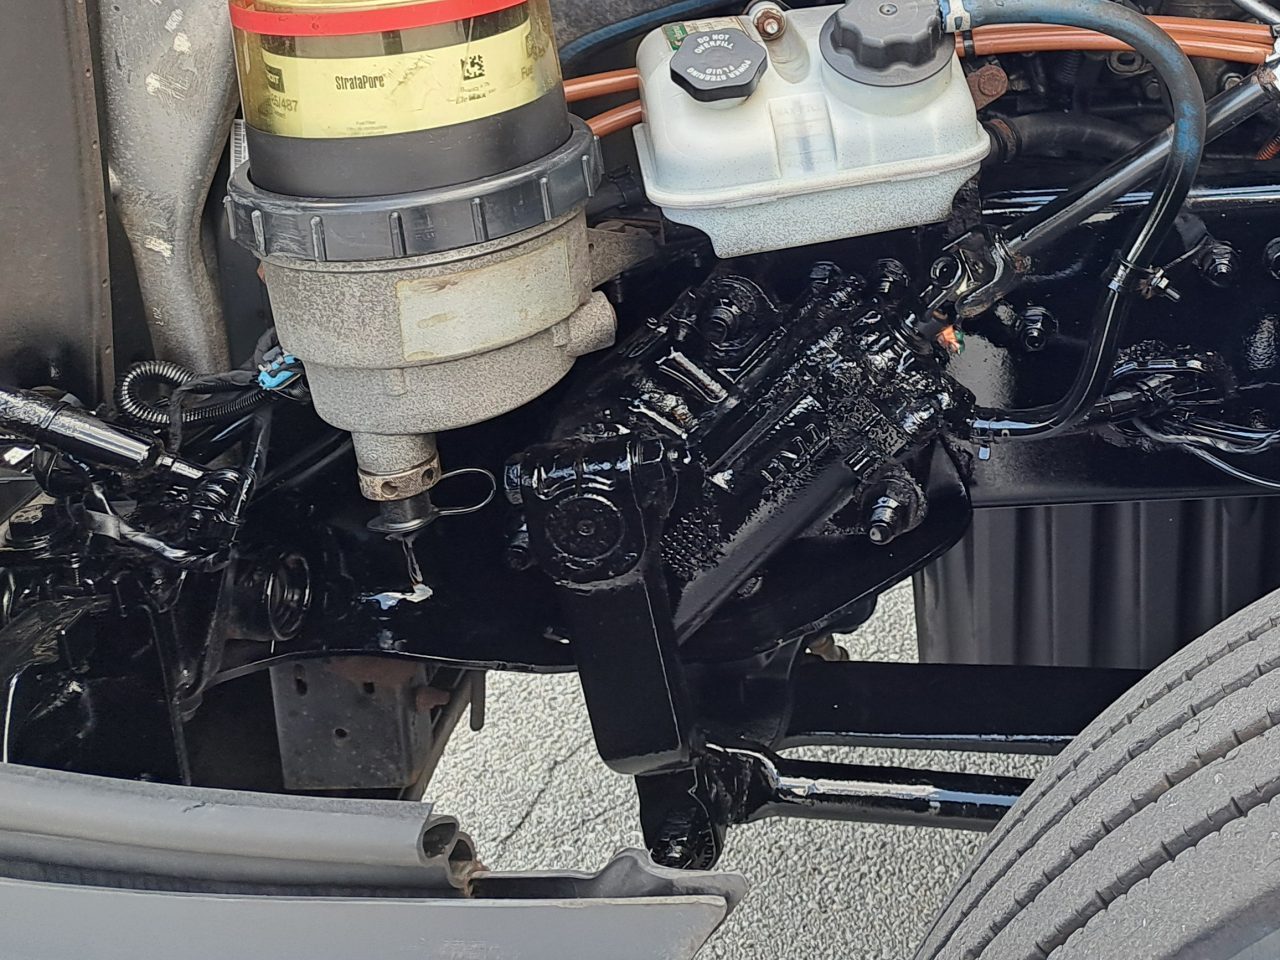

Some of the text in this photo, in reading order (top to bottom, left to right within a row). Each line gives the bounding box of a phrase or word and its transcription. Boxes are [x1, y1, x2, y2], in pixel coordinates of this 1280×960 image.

[697, 35, 710, 44] DO
[694, 41, 734, 54] OVERFILL
[686, 59, 752, 81] POWER STEERING
[705, 65, 735, 75] FLUID
[335, 74, 385, 90] StrataPore
